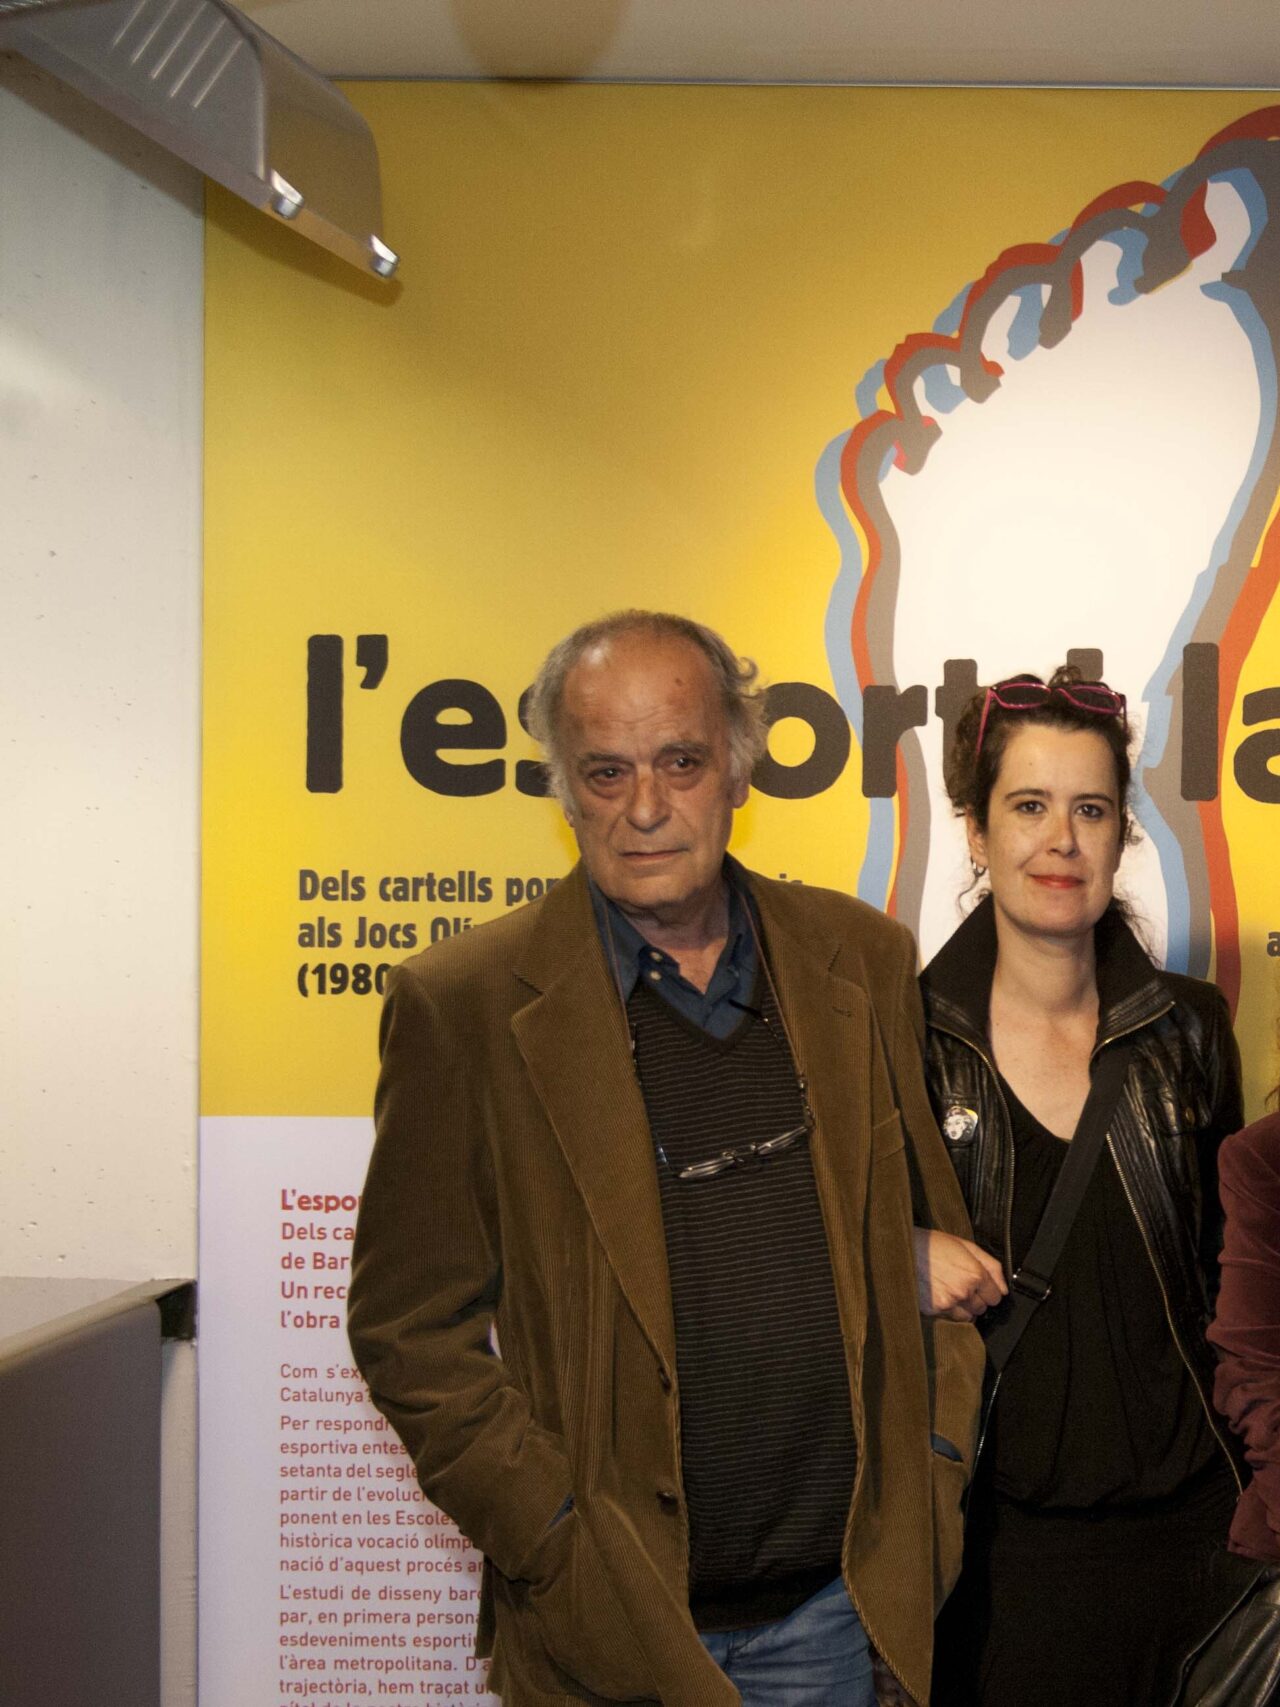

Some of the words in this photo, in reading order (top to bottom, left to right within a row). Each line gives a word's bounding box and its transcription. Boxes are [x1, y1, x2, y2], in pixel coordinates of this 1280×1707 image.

[298, 869, 366, 901] Dels
[378, 870, 493, 903] cartells
[298, 916, 343, 948] als
[354, 916, 418, 949] Jocs
[281, 1223, 327, 1241] Dels
[281, 1252, 305, 1270] de
[281, 1282, 308, 1299] Un
[280, 1311, 341, 1329] l'obra
[280, 1364, 318, 1379] Com
[280, 1416, 309, 1431] Per
[280, 1440, 357, 1458] esportiva
[280, 1464, 342, 1479] setanta
[346, 1463, 372, 1479] del
[280, 1487, 328, 1504] partir
[332, 1487, 352, 1501] de
[280, 1511, 337, 1528] ponent
[342, 1514, 362, 1525] en
[367, 1510, 391, 1525] les
[280, 1533, 352, 1548] històrica
[357, 1533, 419, 1548] vocació
[280, 1556, 324, 1572] nació
[329, 1557, 400, 1575] d'aquest
[407, 1556, 463, 1575] procés
[280, 1585, 344, 1600] L'estudi
[351, 1585, 371, 1600] de
[378, 1585, 442, 1604] disseny
[280, 1611, 312, 1626] par,
[318, 1612, 338, 1624] en
[343, 1608, 411, 1626] primera
[280, 1631, 407, 1648] esdeveniments
[280, 1655, 325, 1671] l'àrea
[333, 1655, 458, 1674] metropolitana.
[280, 1679, 372, 1697] trajectòria,
[378, 1679, 414, 1694] hem
[420, 1680, 469, 1698] traçat
